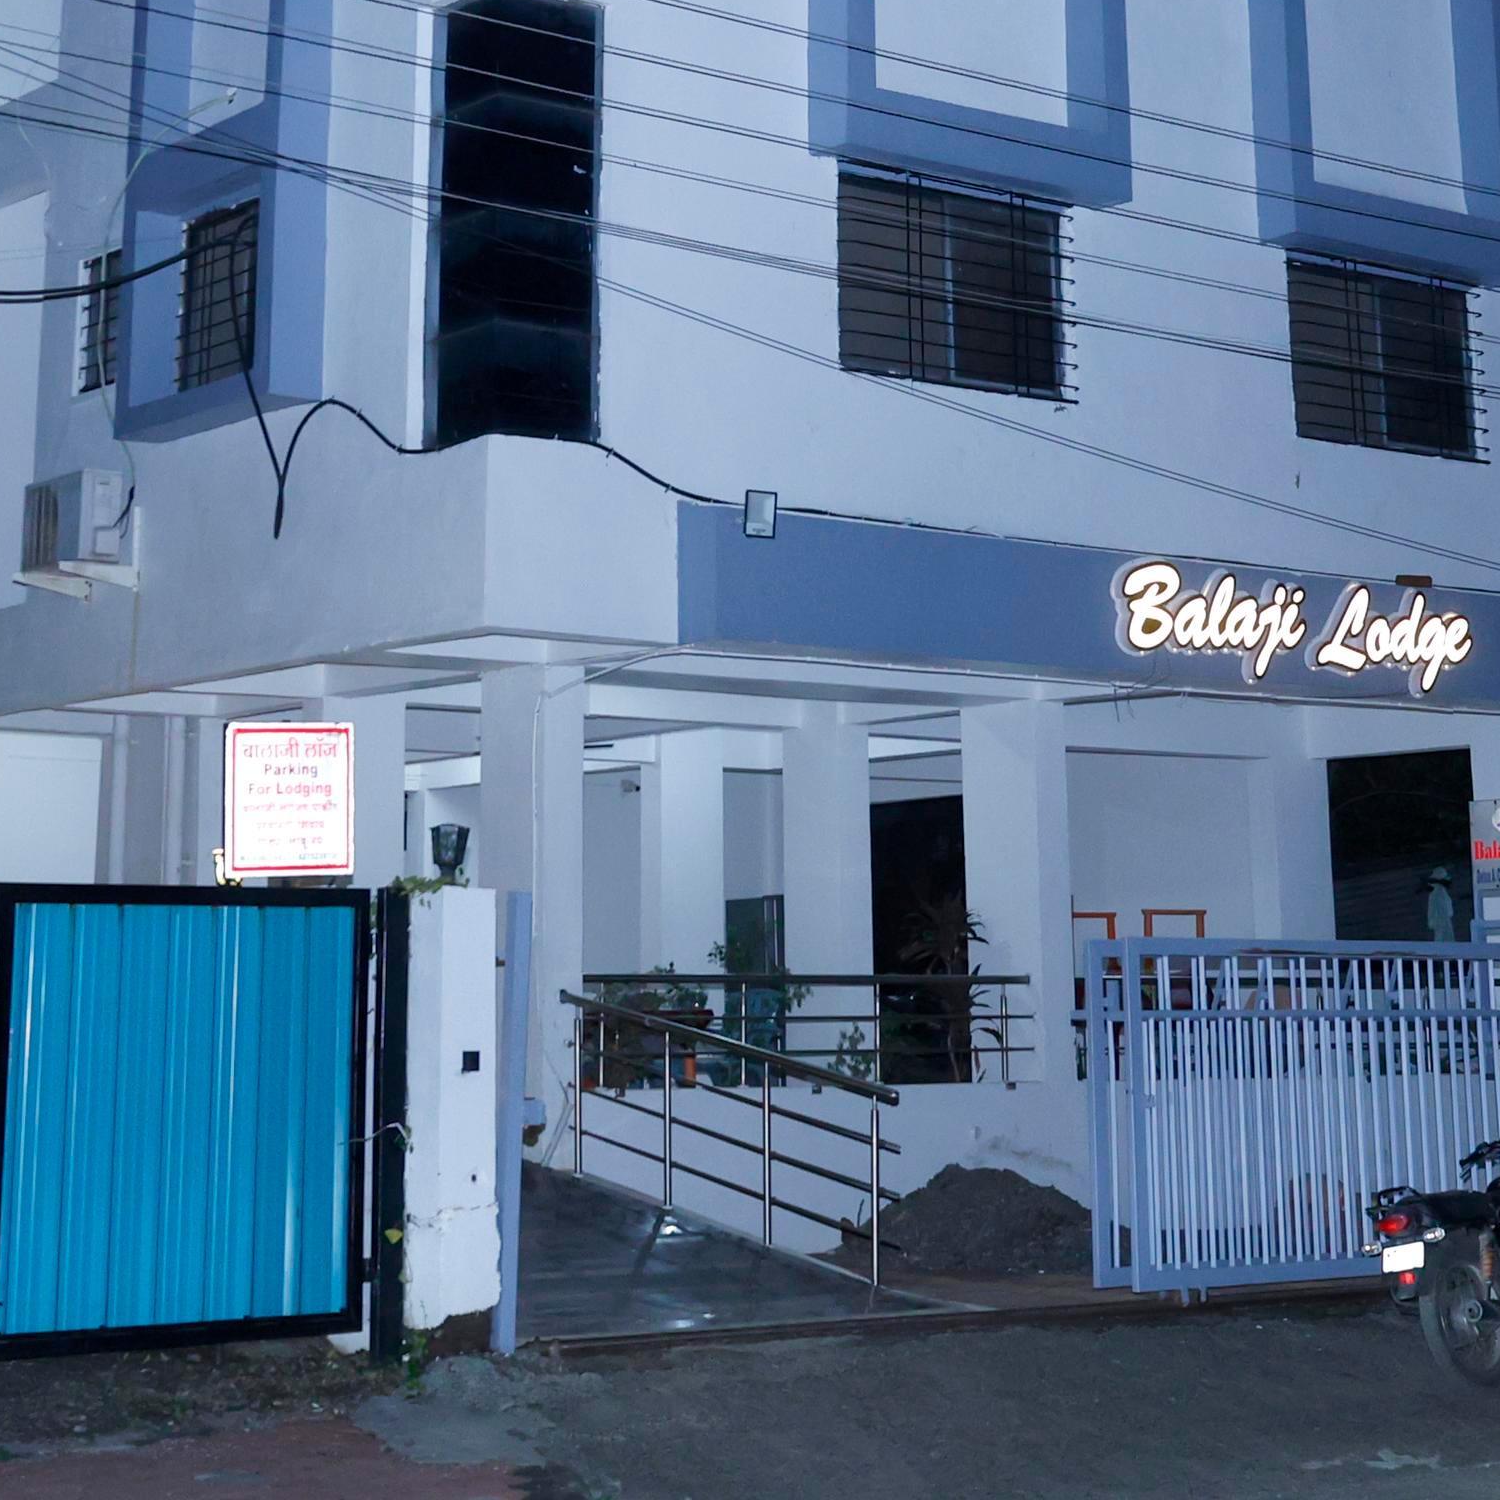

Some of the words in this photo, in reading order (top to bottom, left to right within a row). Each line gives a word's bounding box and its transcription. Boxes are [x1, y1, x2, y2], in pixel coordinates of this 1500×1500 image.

[1113, 558, 1307, 682] Balaji
[1311, 583, 1473, 695] Lodge
[264, 762, 318, 778] Parking
[248, 782, 271, 795] For
[276, 781, 332, 797] Lodging
